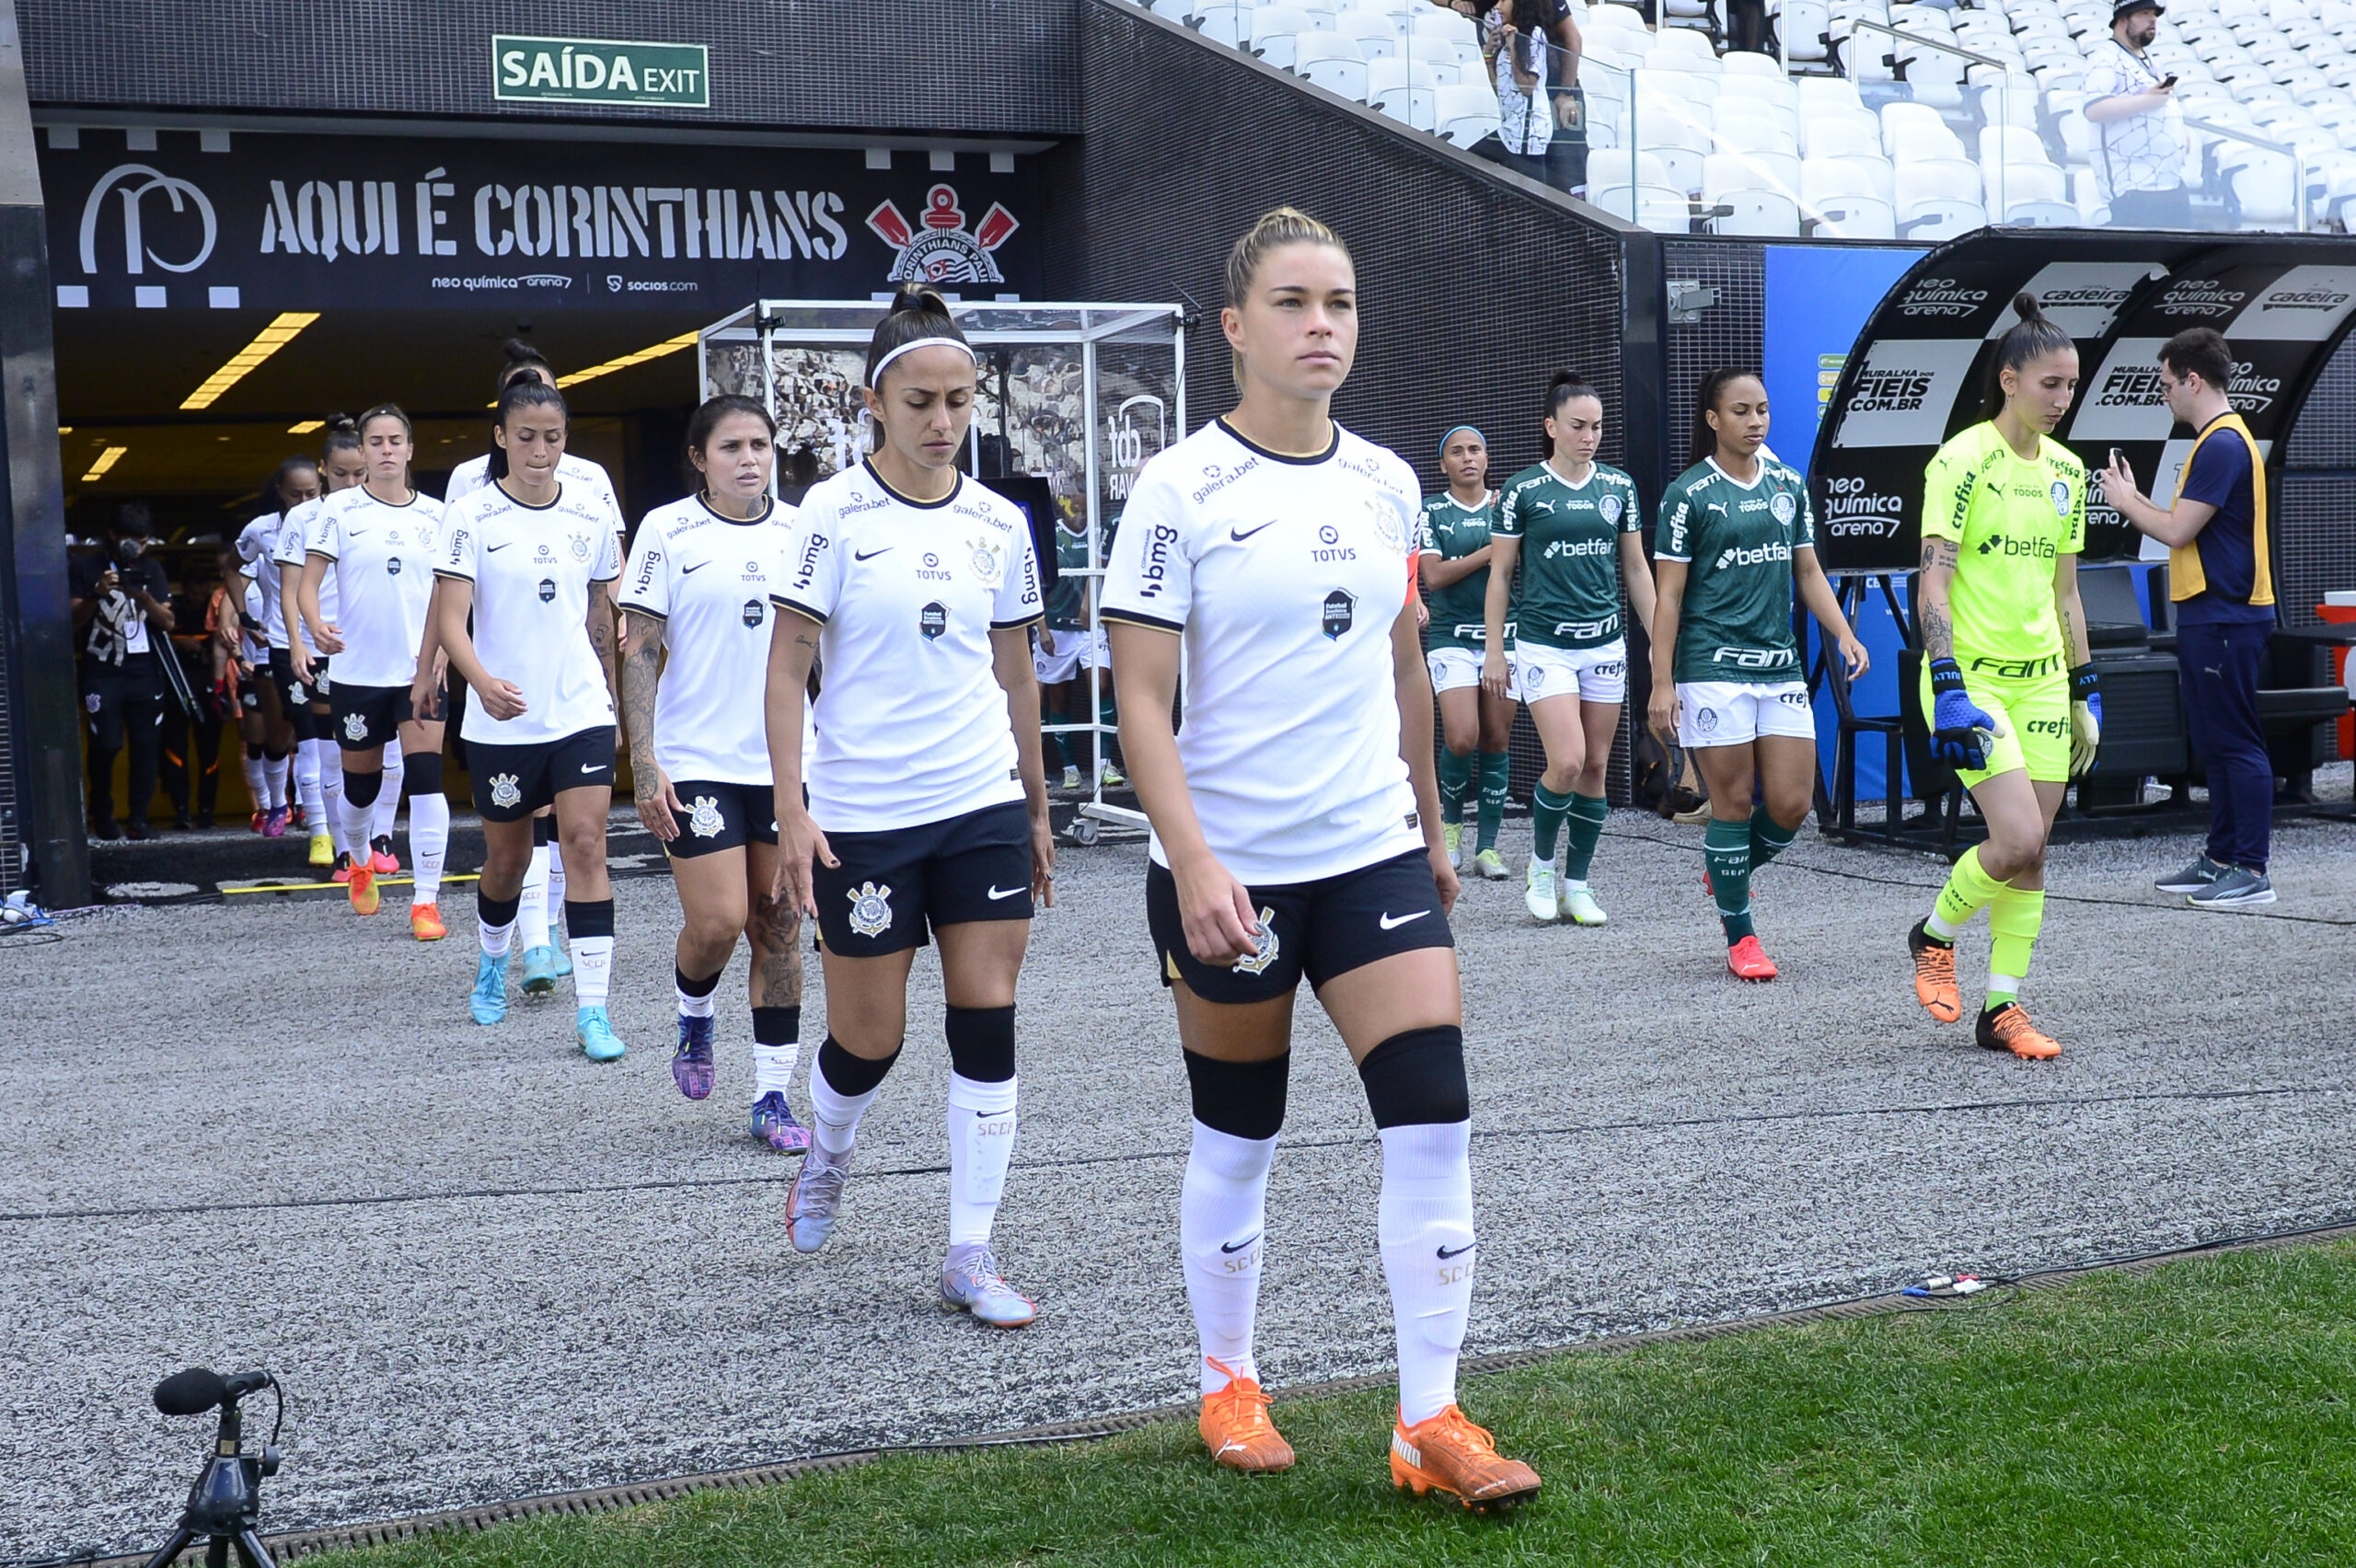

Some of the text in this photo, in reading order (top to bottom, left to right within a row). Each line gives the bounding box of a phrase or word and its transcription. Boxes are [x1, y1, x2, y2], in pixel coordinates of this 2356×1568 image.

[502, 46, 700, 93] SAÍDA EXIT
[260, 179, 399, 263] AQUI
[416, 166, 457, 255] É
[474, 184, 848, 259] CORINTHIANS
[432, 276, 460, 289] neo
[463, 274, 518, 291] química
[628, 279, 698, 292] socios.com
[2173, 280, 2220, 290] neo
[2042, 287, 2131, 301] cadeira
[2164, 288, 2246, 305] química
[2269, 292, 2350, 305] cadeira
[2231, 362, 2253, 375] eo
[1857, 377, 1932, 398] FIEIS
[1848, 398, 1923, 412] .COM.BR
[1192, 456, 1260, 504] galera.bet
[1595, 472, 1632, 489] crefisa
[1765, 467, 1801, 485] crefisa
[1951, 470, 1977, 530] crefisa
[2013, 488, 2043, 498] TODOS
[475, 503, 513, 523] galera.bet
[558, 505, 600, 525] galera.bet
[838, 496, 891, 519] galera.bet
[1501, 490, 1519, 531] crefisa
[1565, 502, 1595, 511] TODOS
[1624, 490, 1638, 532] crefisa
[1738, 502, 1769, 513] TODOS
[319, 516, 337, 539] bmg
[953, 503, 1012, 533] galera.bet
[1671, 502, 1690, 553] crefisa
[666, 517, 711, 540] galera.bet
[451, 529, 469, 558] bmg
[1141, 524, 1178, 581] bmg
[533, 557, 558, 565] TOTVS
[798, 533, 828, 578] bmg
[1311, 548, 1357, 563] TOTVS
[1737, 541, 1792, 567] betfai
[637, 550, 662, 585] bmg
[916, 569, 953, 582] TOTVS
[740, 574, 767, 582] TOTVS
[1021, 559, 1039, 605] bmg
[1438, 1262, 1474, 1286] SCC
